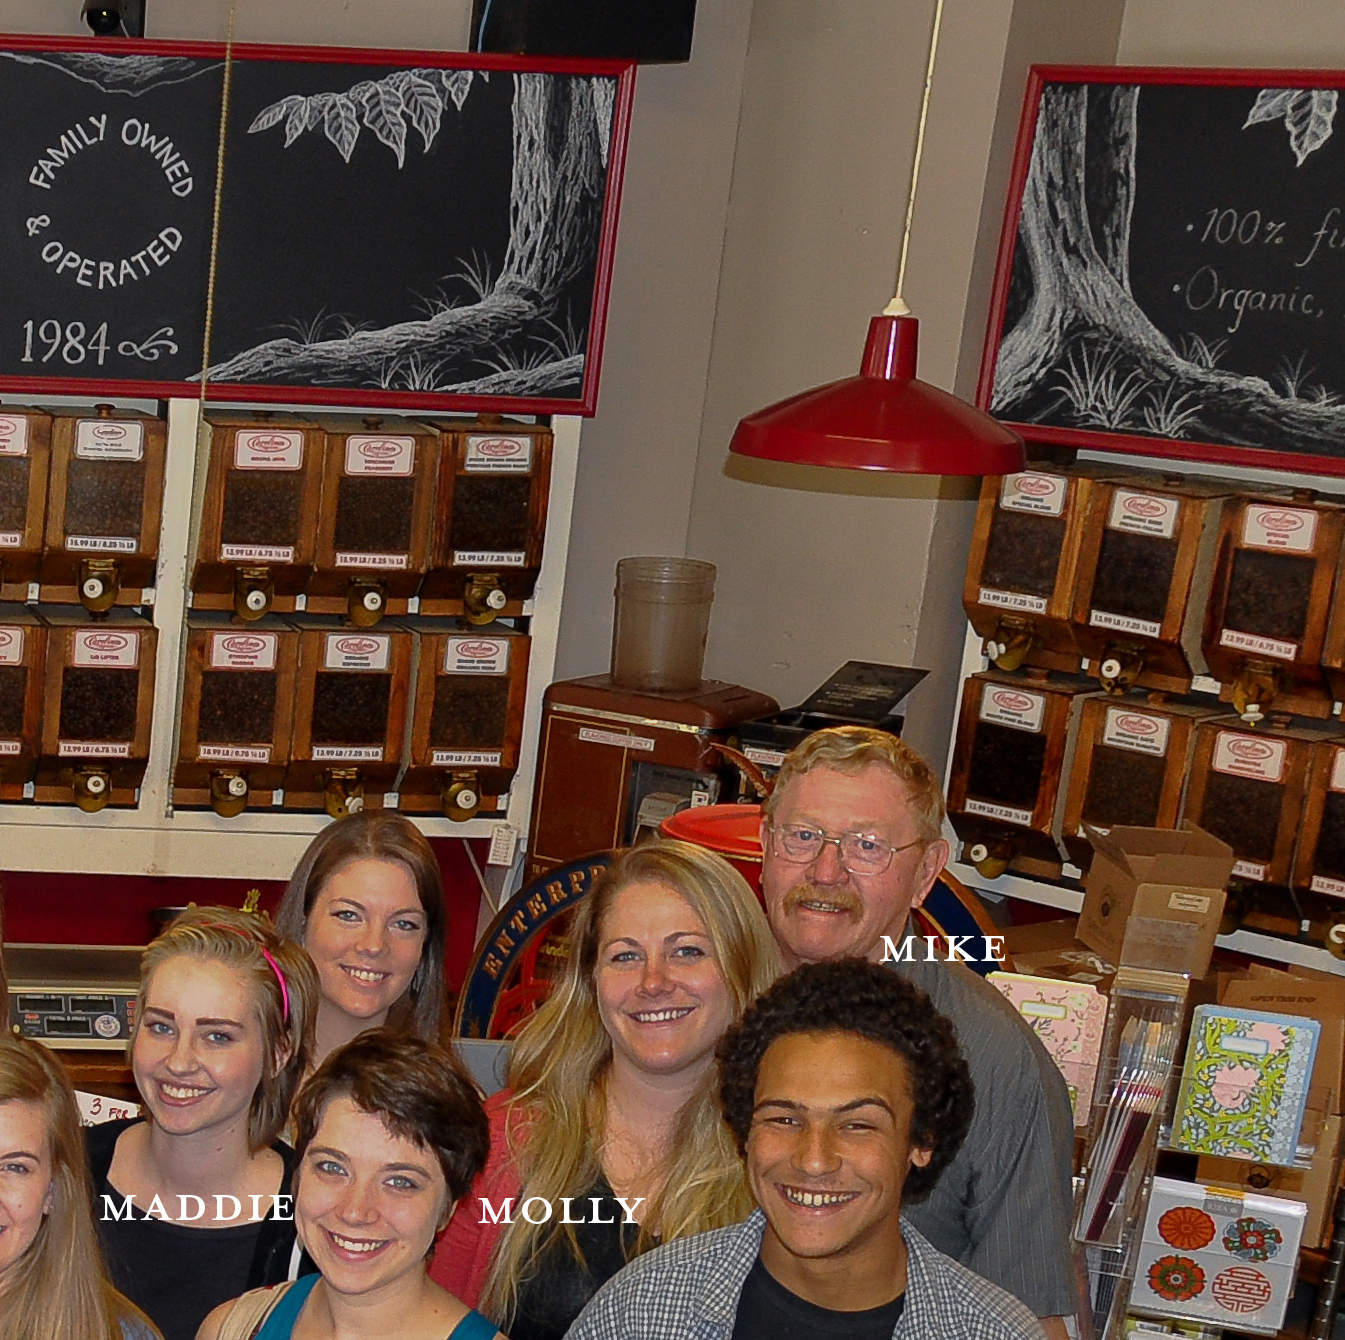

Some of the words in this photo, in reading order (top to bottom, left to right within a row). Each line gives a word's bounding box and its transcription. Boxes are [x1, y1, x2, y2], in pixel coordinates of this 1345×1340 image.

[29, 113, 107, 189] FAMILY
[121, 118, 194, 198] OWNED
[26, 213, 51, 237] &
[41, 226, 184, 291] OPERATED
[1201, 207, 1287, 244] 100%
[1186, 264, 1324, 334] Organic,
[20, 319, 112, 367] 1984
[89, 1097, 102, 1116] 3
